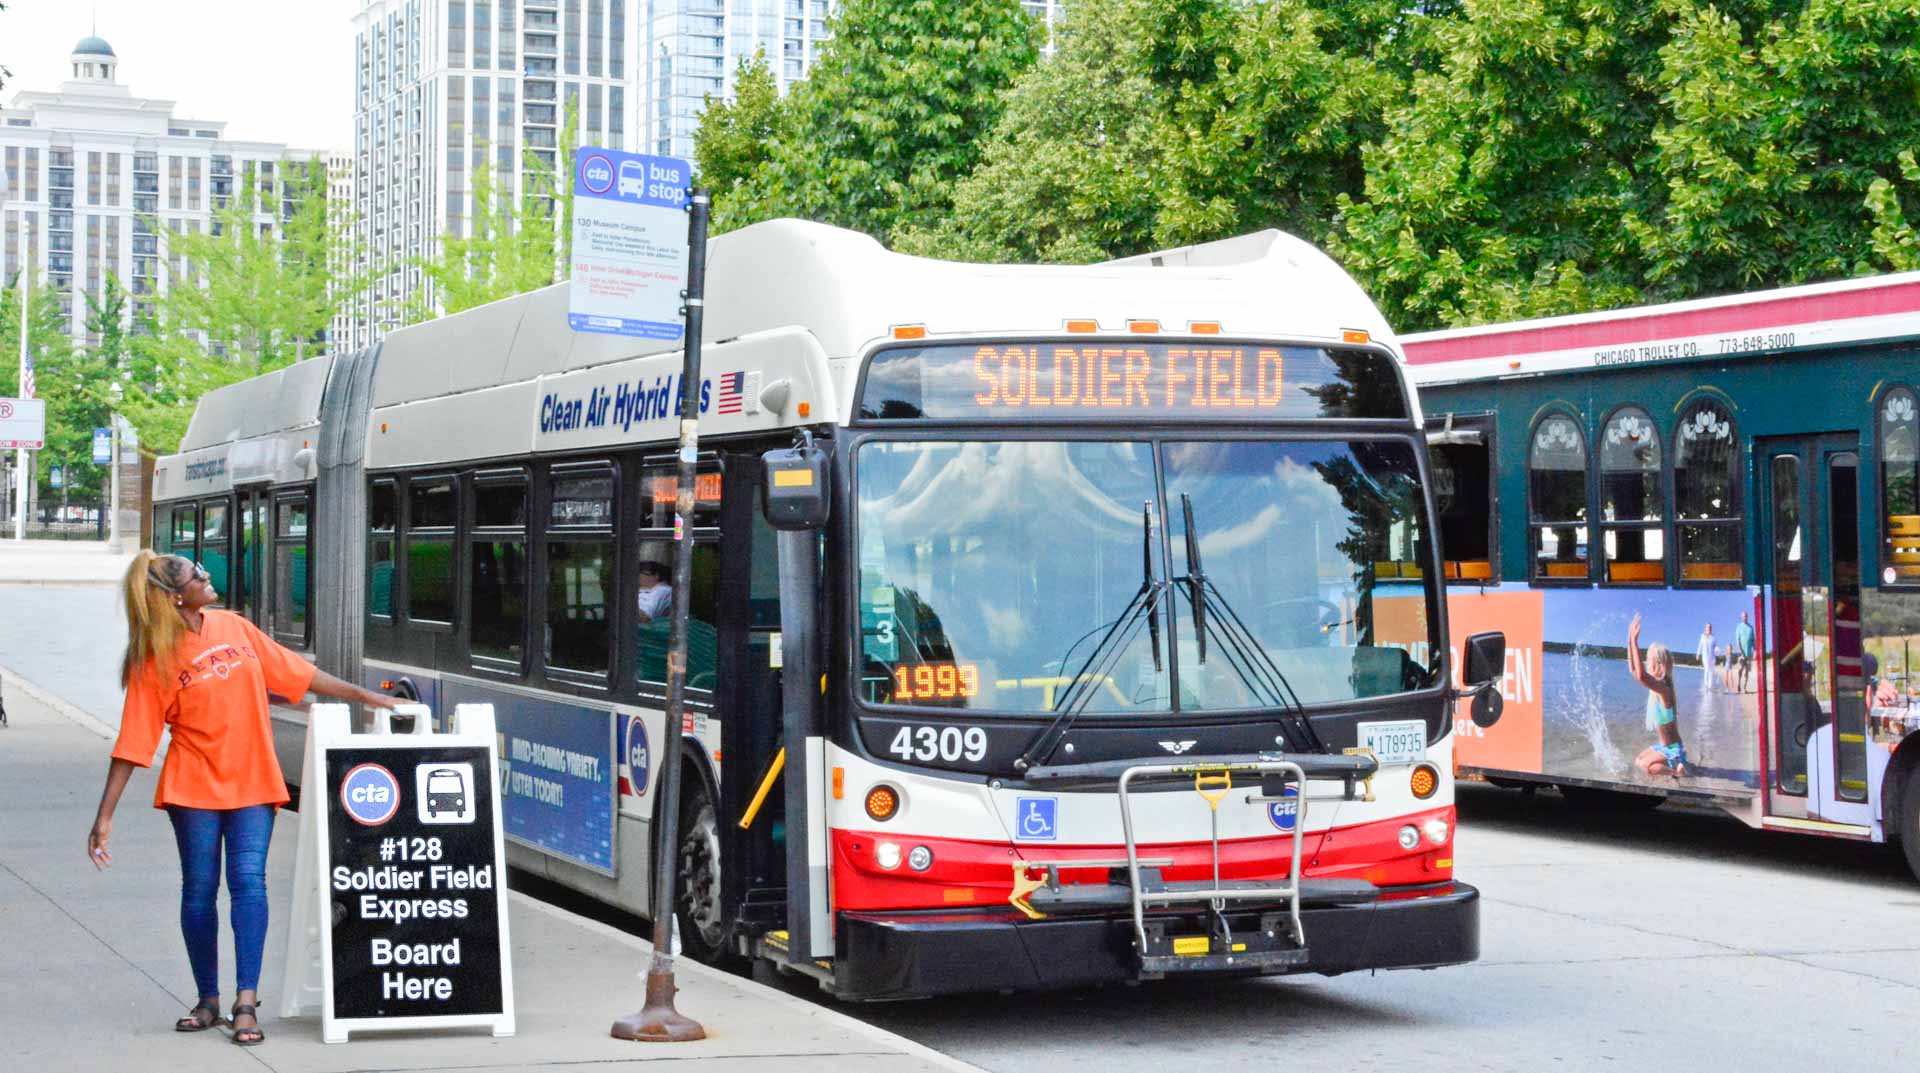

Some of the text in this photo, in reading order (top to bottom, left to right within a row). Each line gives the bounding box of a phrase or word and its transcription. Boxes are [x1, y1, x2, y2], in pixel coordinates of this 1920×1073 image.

[587, 168, 609, 181] cta
[650, 163, 680, 183] bus
[648, 183, 685, 204] stop
[577, 218, 591, 227] 130
[1594, 332, 1796, 366] CHICAGO TROLLEY CO. 773-648-5000
[974, 347, 1284, 407] SOLDIER FIELD
[540, 373, 712, 433] Clean Air Hybrid Bs
[876, 620, 895, 644] 3
[179, 646, 257, 688] BEARS
[895, 663, 979, 699] 1999
[631, 743, 647, 769] cta
[890, 726, 988, 762] 4309
[351, 783, 390, 803] cta
[380, 837, 443, 861] #128
[333, 865, 492, 890] Soldier Field
[360, 895, 469, 925] Express
[371, 938, 461, 966] Board
[383, 972, 453, 1000] Here
